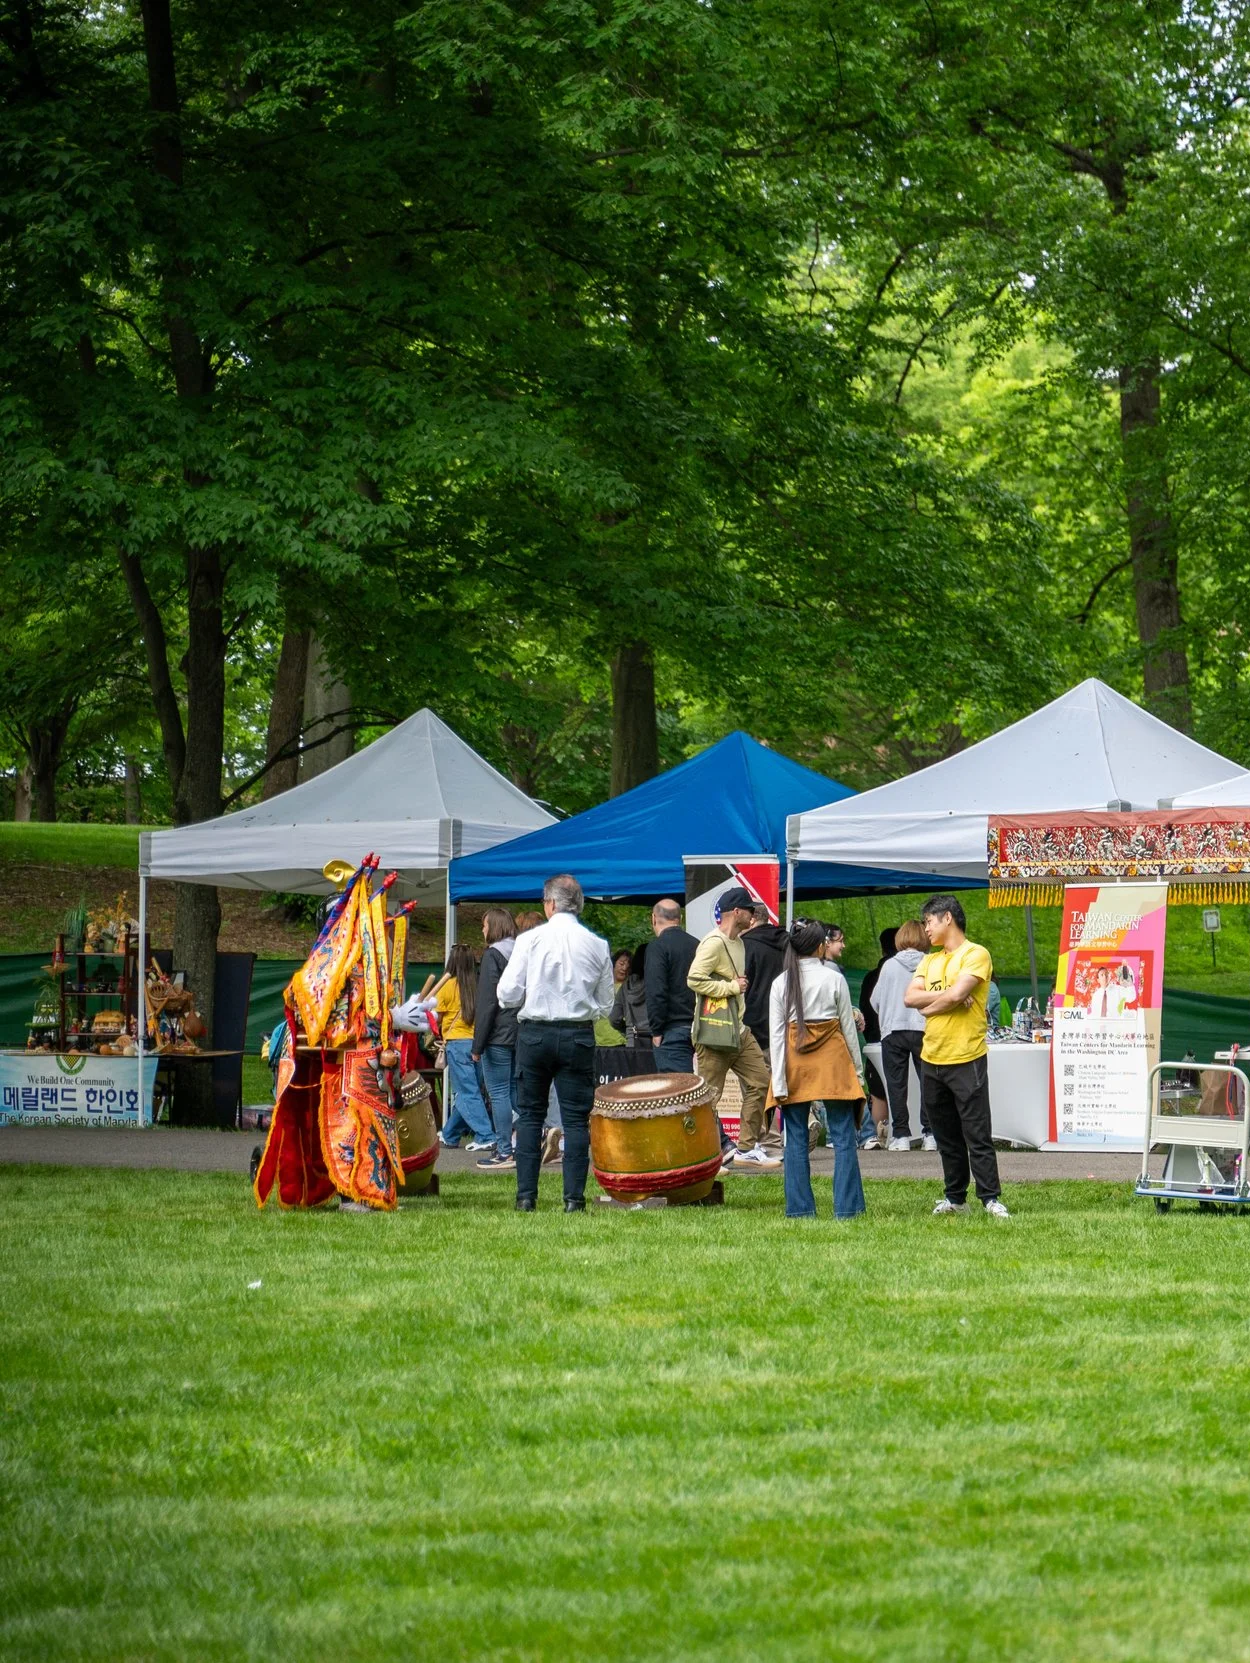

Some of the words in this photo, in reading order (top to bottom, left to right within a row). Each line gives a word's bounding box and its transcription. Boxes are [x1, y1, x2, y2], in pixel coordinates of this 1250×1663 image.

[1071, 911, 1112, 922] TAIWAN
[1070, 923, 1084, 931] FOR
[1085, 921, 1139, 931] MANDARIN
[1069, 930, 1118, 940] LEARNING
[1060, 1011, 1084, 1020] TCML
[27, 1075, 39, 1085] We
[40, 1075, 59, 1085] Build
[60, 1076, 74, 1085] One
[75, 1076, 116, 1088] Community
[3, 1086, 78, 1112] 메릴랜드
[18, 1114, 52, 1124] Korean
[54, 1114, 91, 1126] Society
[92, 1115, 102, 1126] of
[103, 1116, 149, 1127] Marylad
